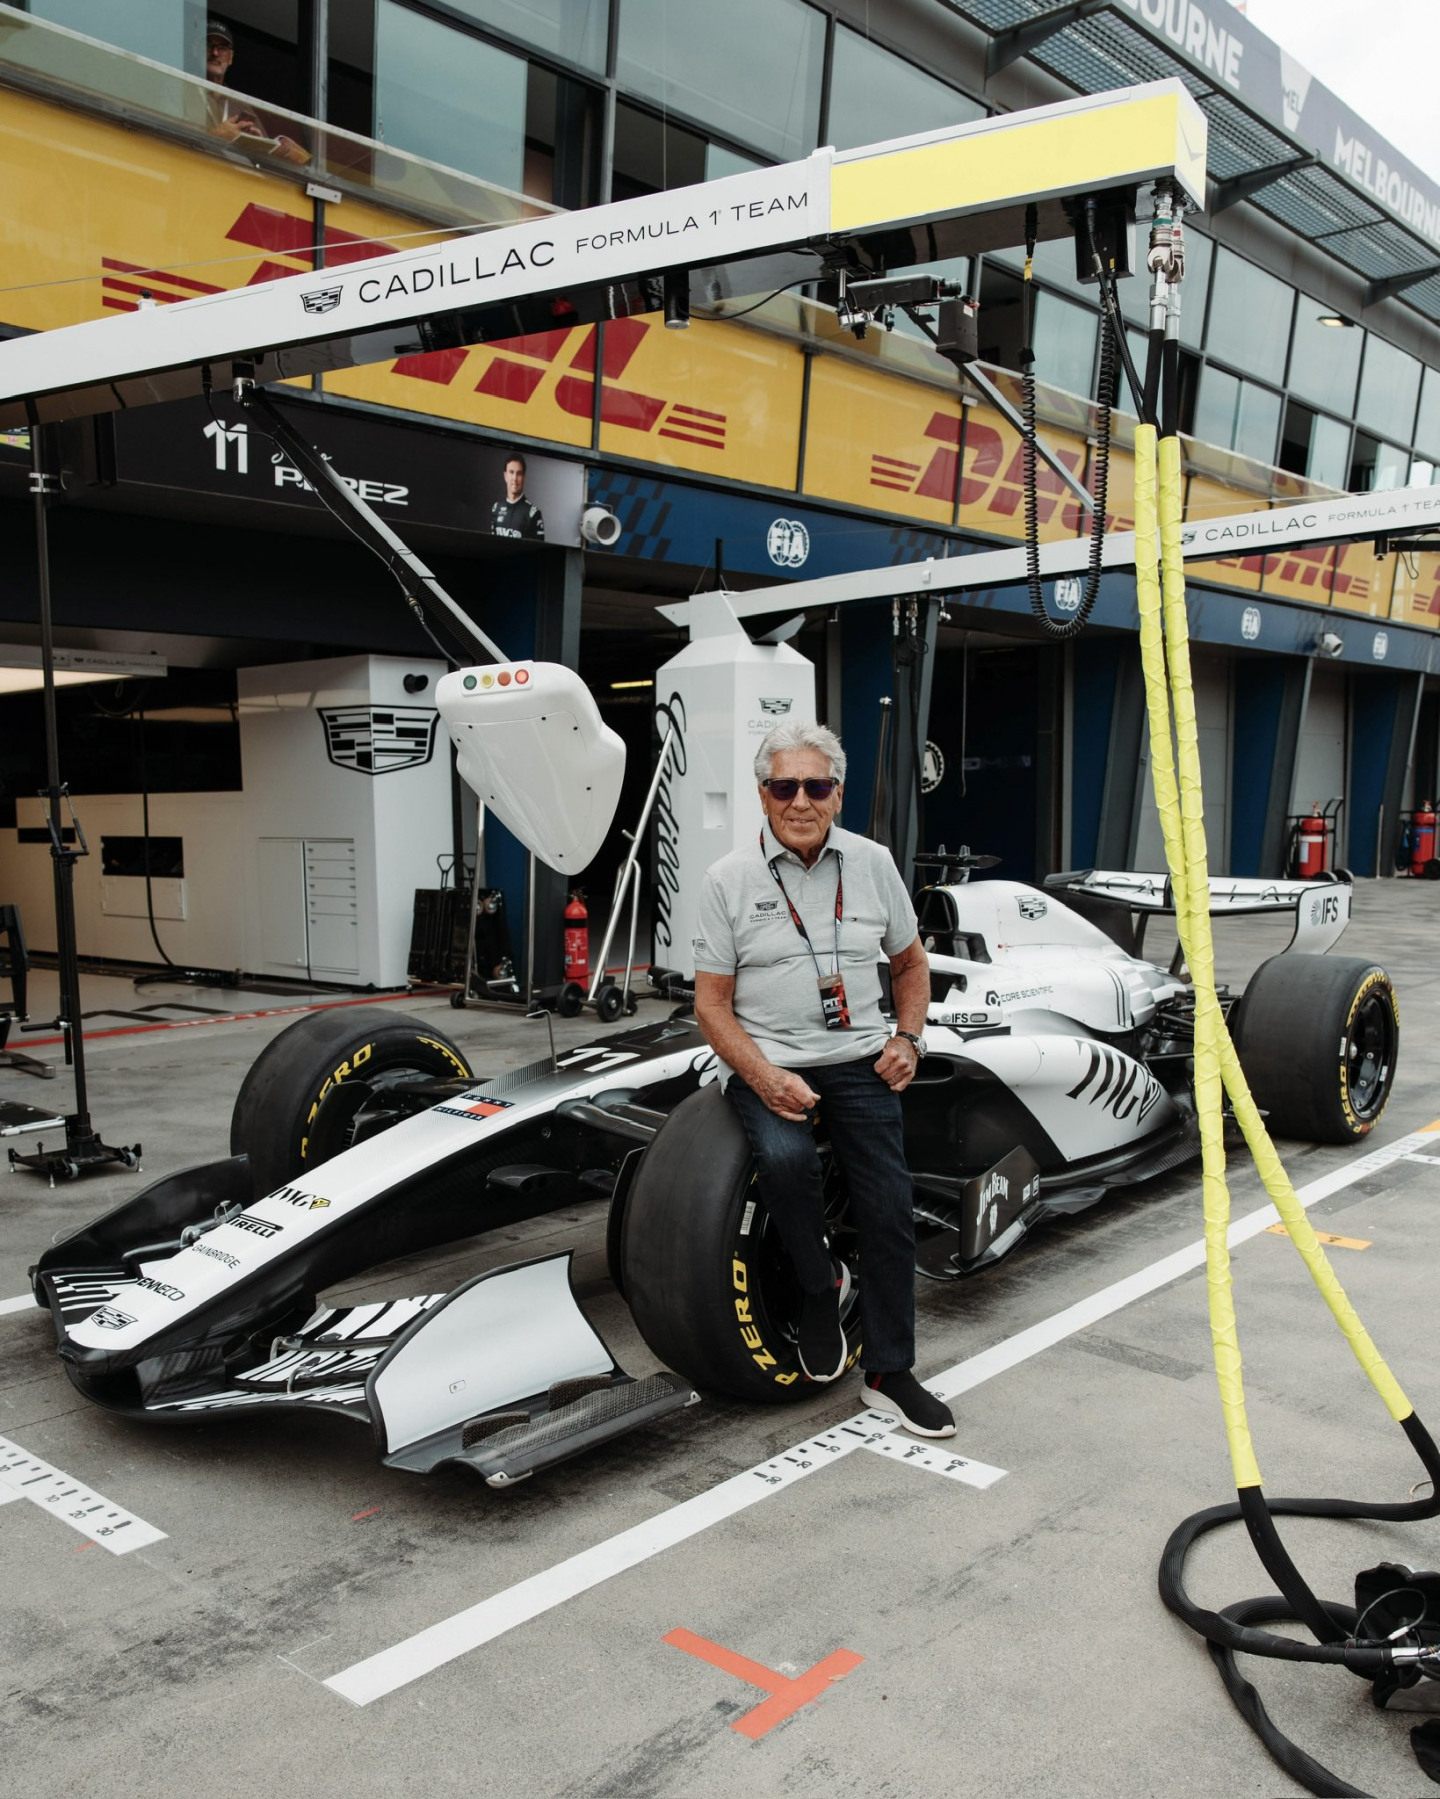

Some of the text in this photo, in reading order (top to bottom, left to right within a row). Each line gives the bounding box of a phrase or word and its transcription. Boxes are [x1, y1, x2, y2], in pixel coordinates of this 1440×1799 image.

[1115, 0, 1244, 89] OURNE
[358, 241, 555, 303] CADILLAC
[576, 216, 699, 254] FORMULA
[731, 191, 808, 221] TEAM
[203, 419, 248, 474] 11
[274, 465, 409, 505] PEZ
[1205, 515, 1318, 541] CADILLAC
[1328, 505, 1397, 522] FORMULA
[748, 719, 776, 729] CADI
[655, 692, 687, 948] Cadillac
[749, 910, 787, 919] CADILLAC
[1321, 896, 1339, 925] IFS
[1000, 991, 1021, 1003] CORE
[951, 1013, 969, 1023] IFS
[556, 1048, 641, 1073] 11
[192, 1244, 240, 1269] GAINBRIDGE
[136, 1277, 186, 1301] ENNECO
[732, 1259, 777, 1371] ZERO
